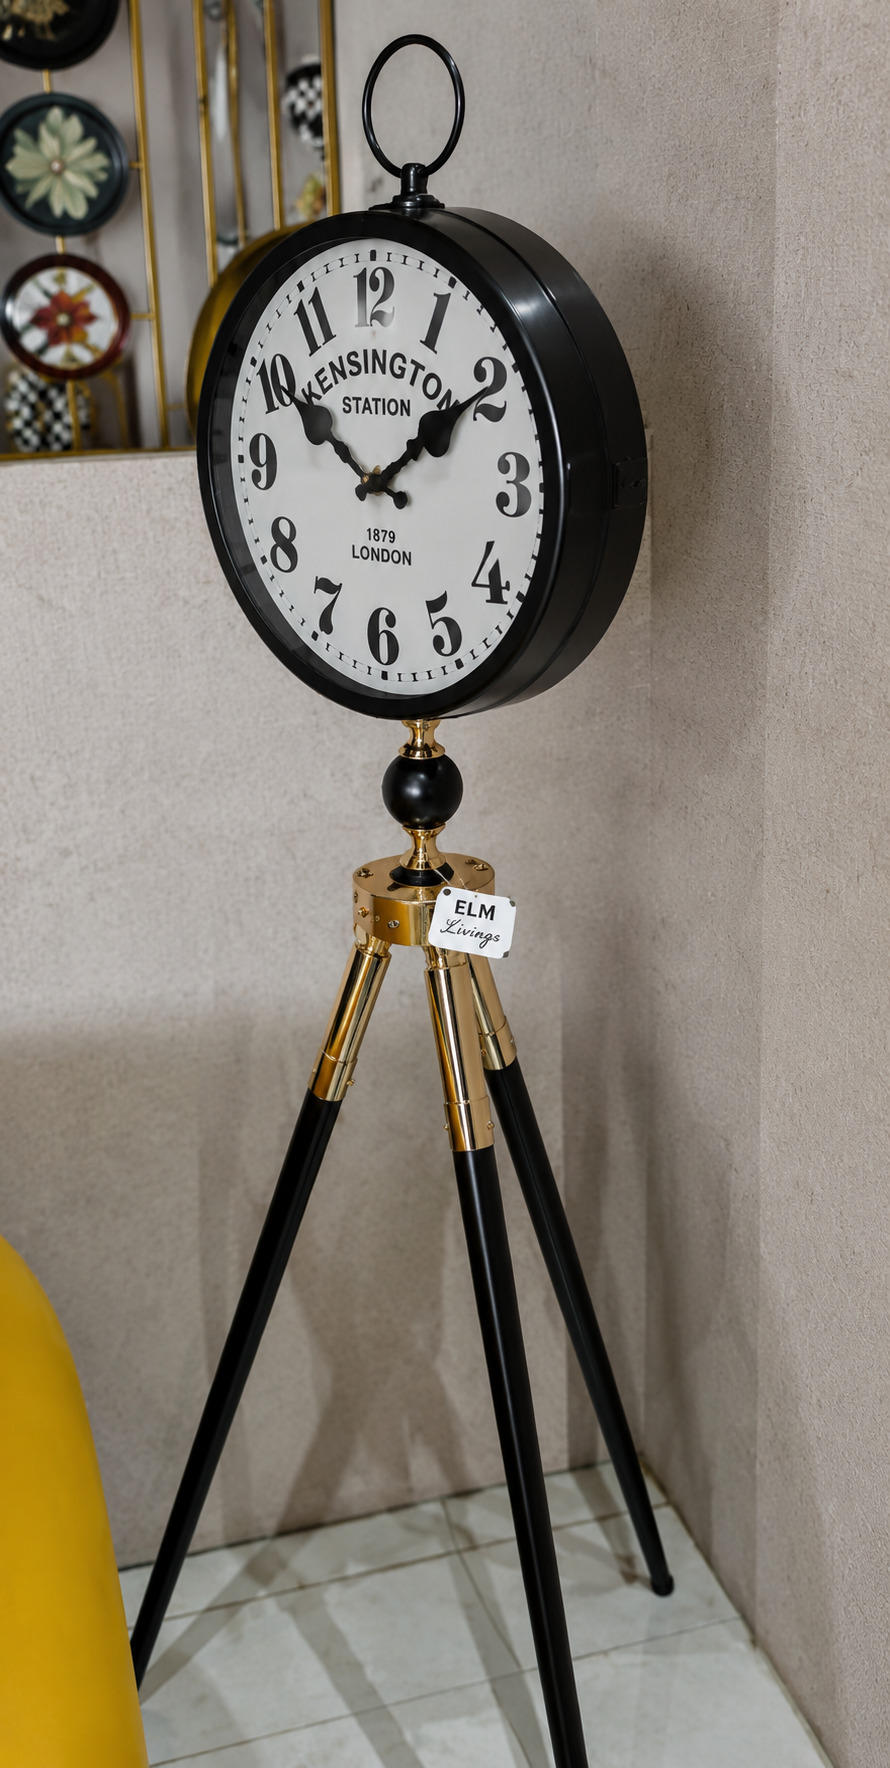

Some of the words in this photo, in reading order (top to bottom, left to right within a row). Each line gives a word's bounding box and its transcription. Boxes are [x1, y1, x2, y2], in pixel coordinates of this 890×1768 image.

[293, 286, 337, 357] 11
[353, 266, 395, 328] 12
[419, 291, 452, 355] 1
[256, 353, 296, 415] 10
[342, 396, 411, 417] STATION
[473, 356, 508, 423] 2
[249, 432, 278, 490] 9
[495, 451, 532, 517] 3
[270, 516, 298, 573] 8
[351, 544, 412, 566] LONDON
[366, 527, 396, 543] 1879
[471, 540, 511, 605] 4
[313, 575, 343, 635] 7
[425, 590, 463, 657] 5
[367, 607, 400, 666] 6
[440, 918, 501, 949] Livings
[454, 899, 496, 921] ELM
